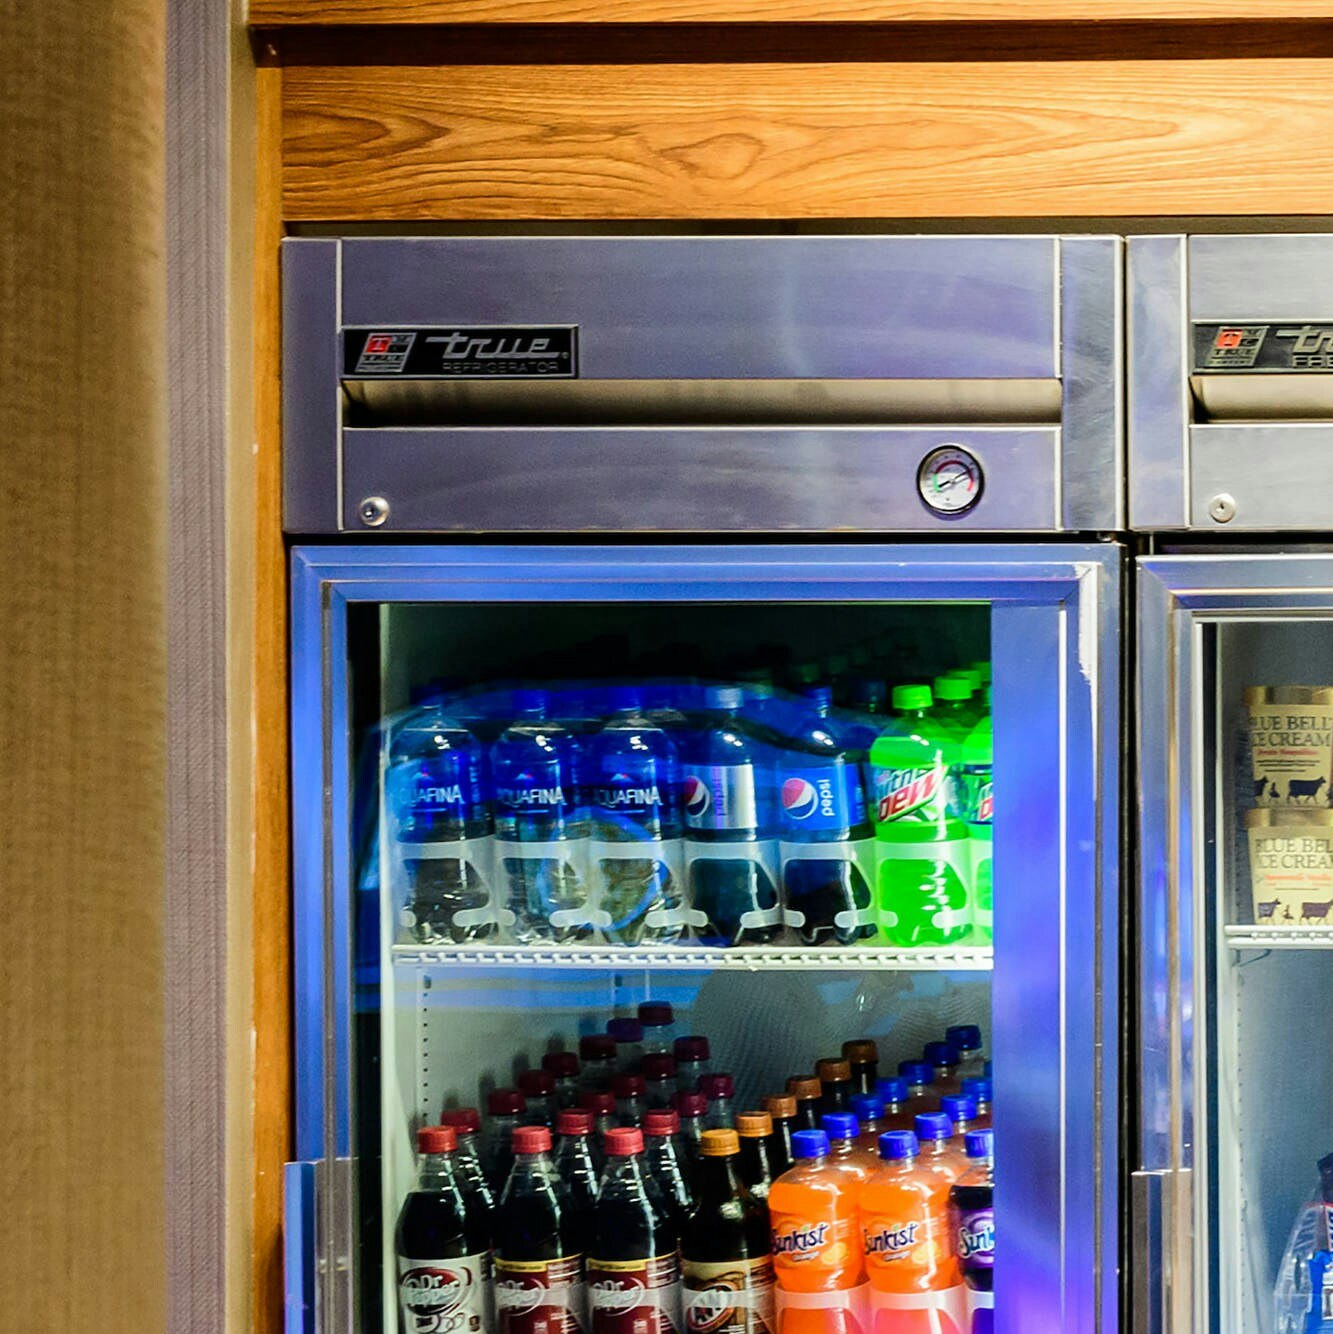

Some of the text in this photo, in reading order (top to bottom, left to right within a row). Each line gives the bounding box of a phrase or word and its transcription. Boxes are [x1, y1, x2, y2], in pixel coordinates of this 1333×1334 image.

[442, 361, 559, 373] REFRIGERATOR
[1269, 732, 1331, 748] CREAM
[817, 778, 835, 818] pepsi
[1255, 838, 1295, 853] BLUE
